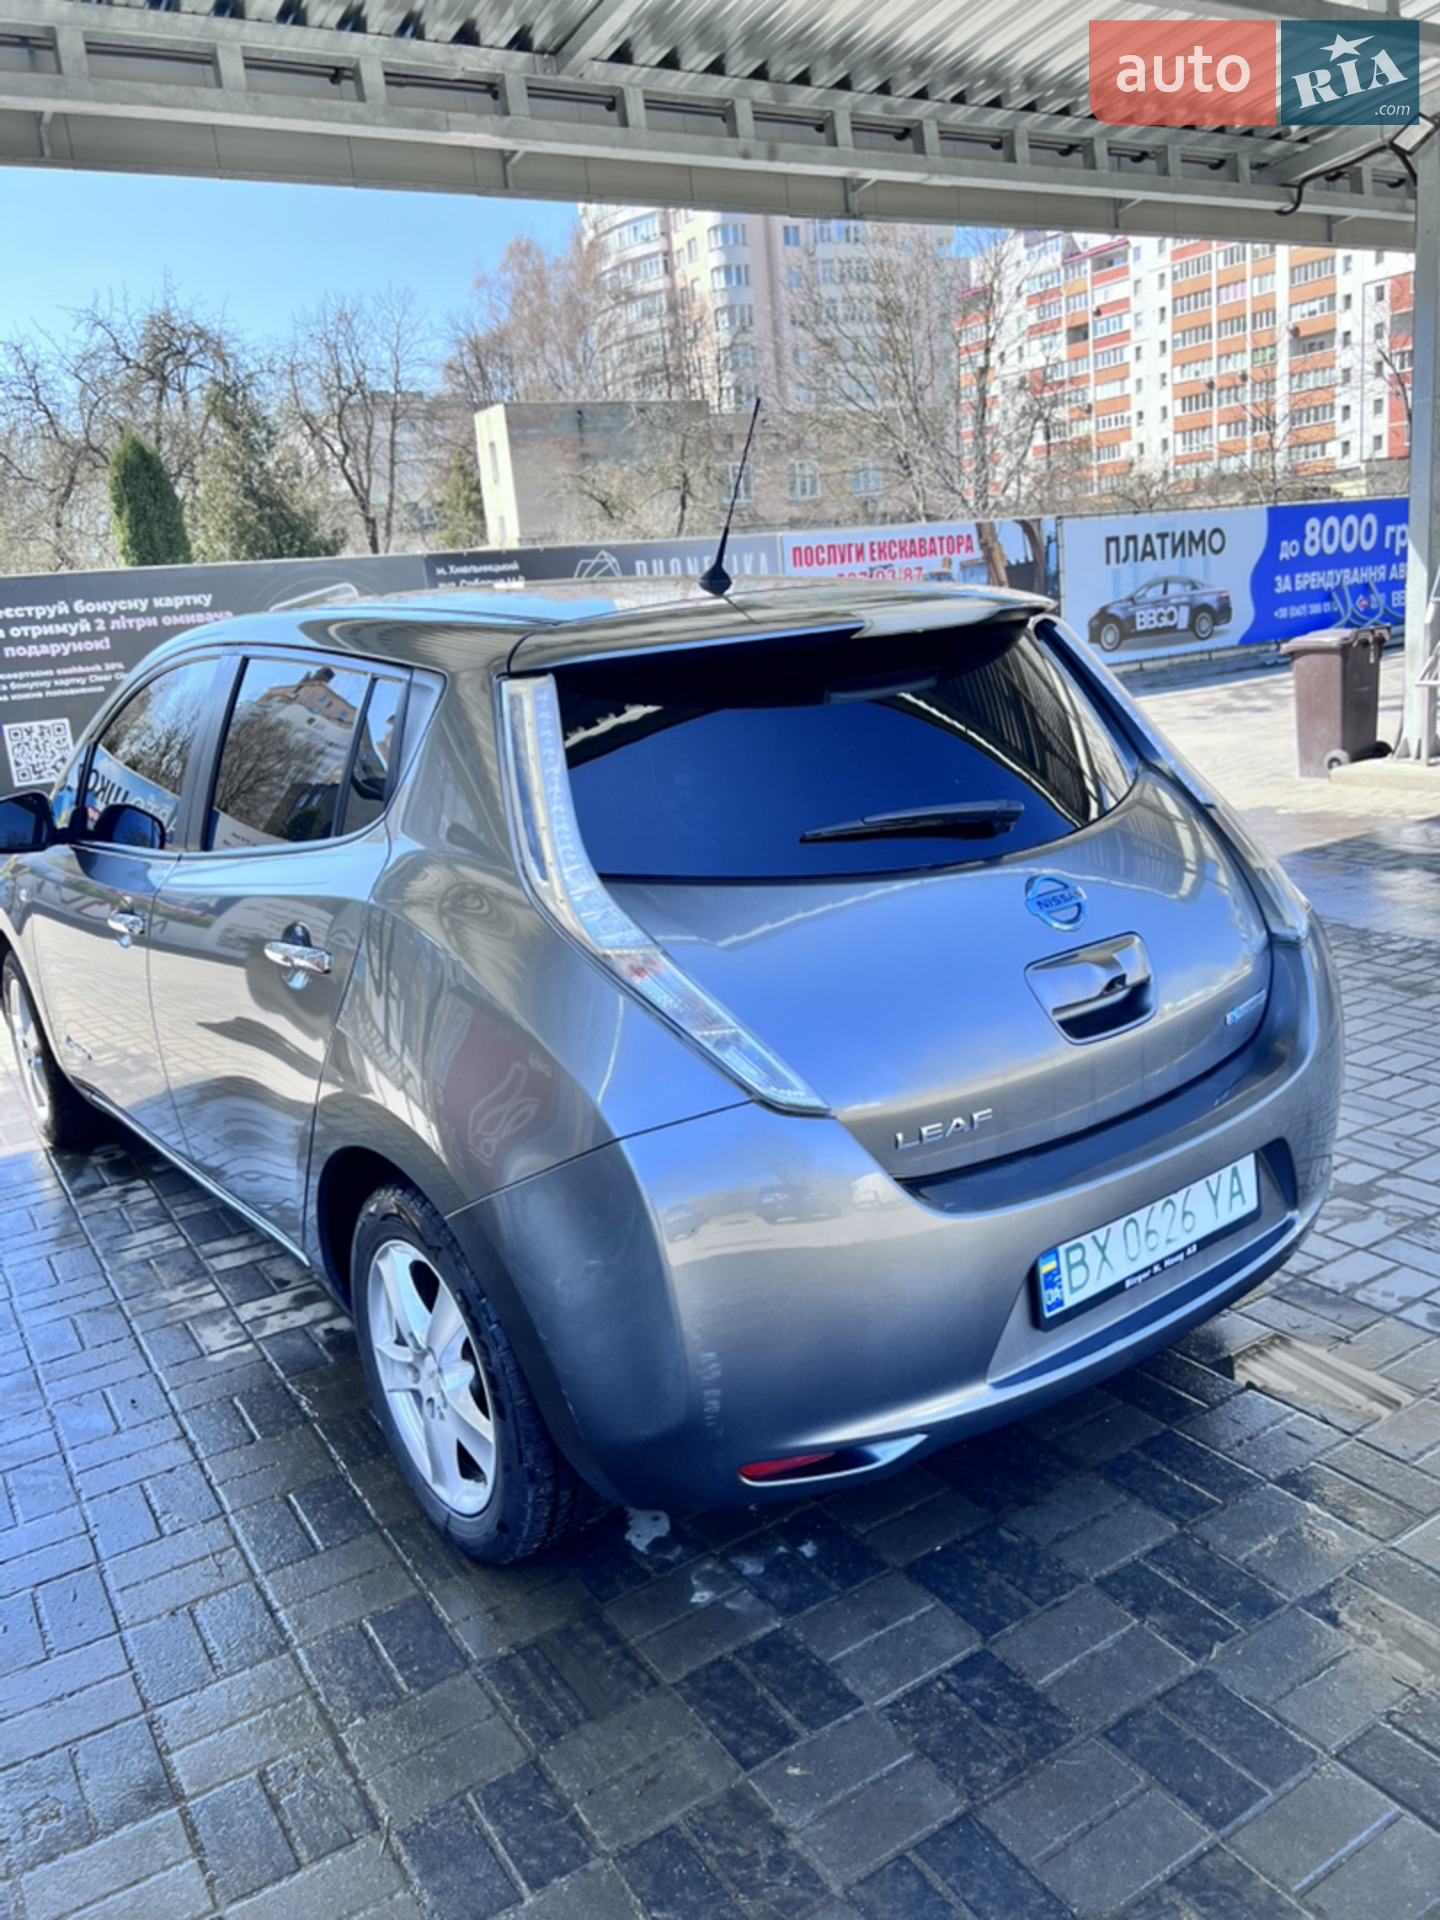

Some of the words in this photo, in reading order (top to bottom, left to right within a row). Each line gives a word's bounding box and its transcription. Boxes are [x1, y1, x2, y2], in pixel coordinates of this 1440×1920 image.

[792, 543, 865, 568] ПОСЛУГИ
[868, 533, 975, 562] ЕКСКАВАТОРА
[1105, 527, 1226, 566] ПЛАТИМО
[1279, 540, 1300, 561] до
[1304, 512, 1378, 557] 8000
[1273, 574, 1292, 594] ЗА
[1294, 564, 1387, 592] БРЕНДУВАННЯ
[73, 598, 149, 614] бонусну
[152, 593, 212, 610] картку
[1135, 605, 1178, 630] BBGO
[9, 618, 92, 639] отримуй
[94, 618, 107, 631] 2
[110, 614, 158, 631] літри
[3, 636, 112, 658] подарунок!
[1036, 888, 1083, 911] NISSAN
[894, 1108, 993, 1150] LEAF
[1065, 1227, 1115, 1295] BX
[1122, 1188, 1196, 1263] 0626
[1205, 1165, 1247, 1221] YA
